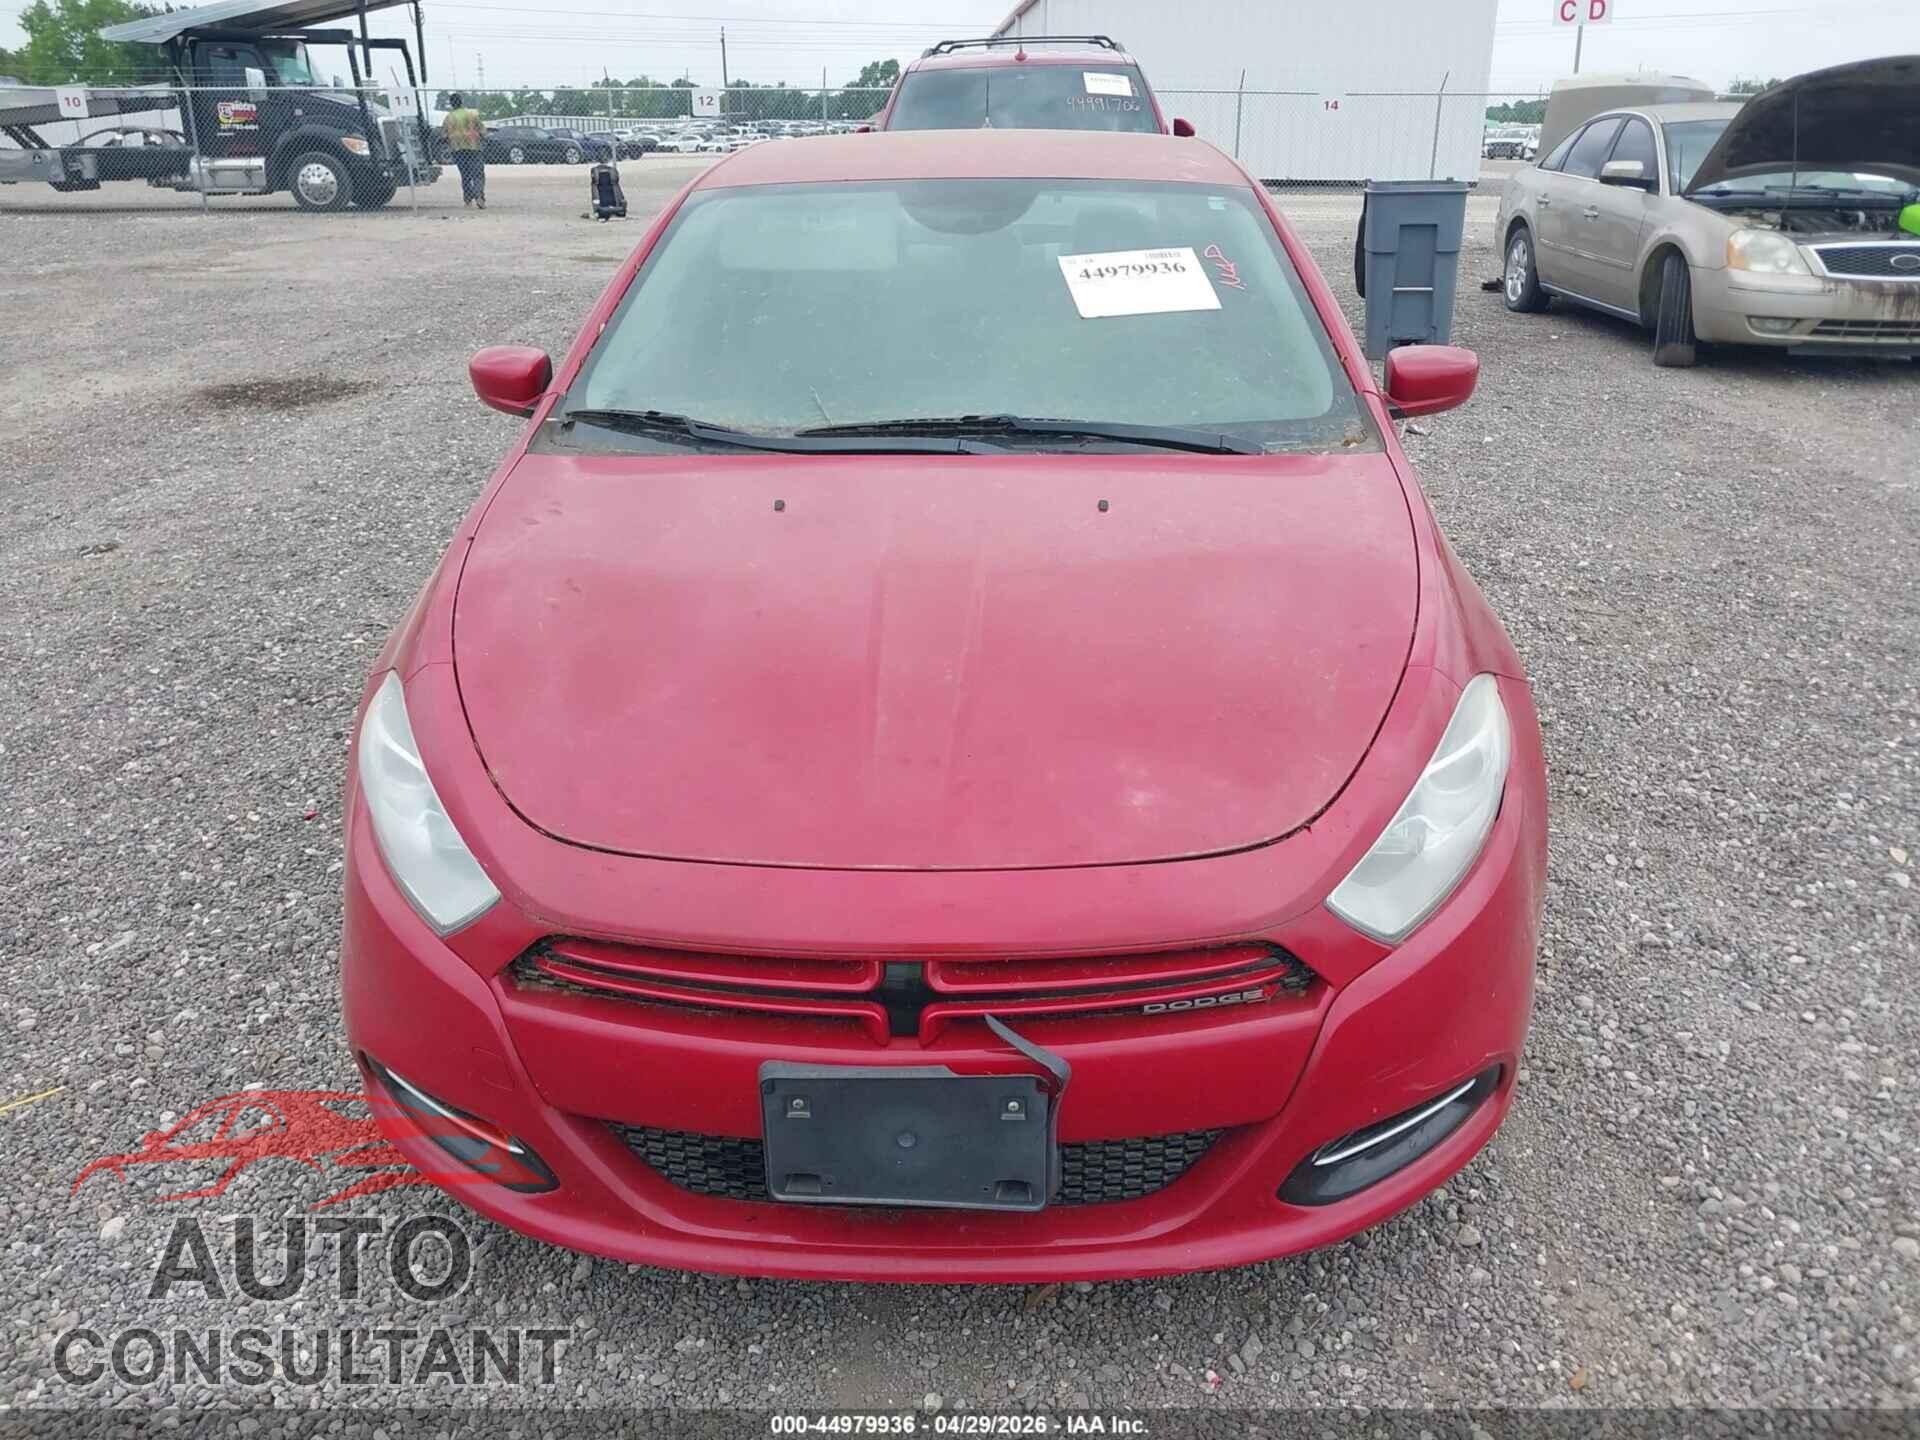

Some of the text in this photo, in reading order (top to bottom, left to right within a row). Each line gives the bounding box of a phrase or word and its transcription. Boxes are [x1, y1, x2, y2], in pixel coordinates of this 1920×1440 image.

[1560, 0, 1577, 22] C
[1588, 0, 1606, 20] D
[64, 96, 81, 108] 10
[394, 95, 409, 106] 11
[698, 95, 714, 106] 12
[1324, 100, 1339, 111] 14
[1079, 262, 1187, 280] 44979936
[1142, 989, 1266, 1015] DODGE
